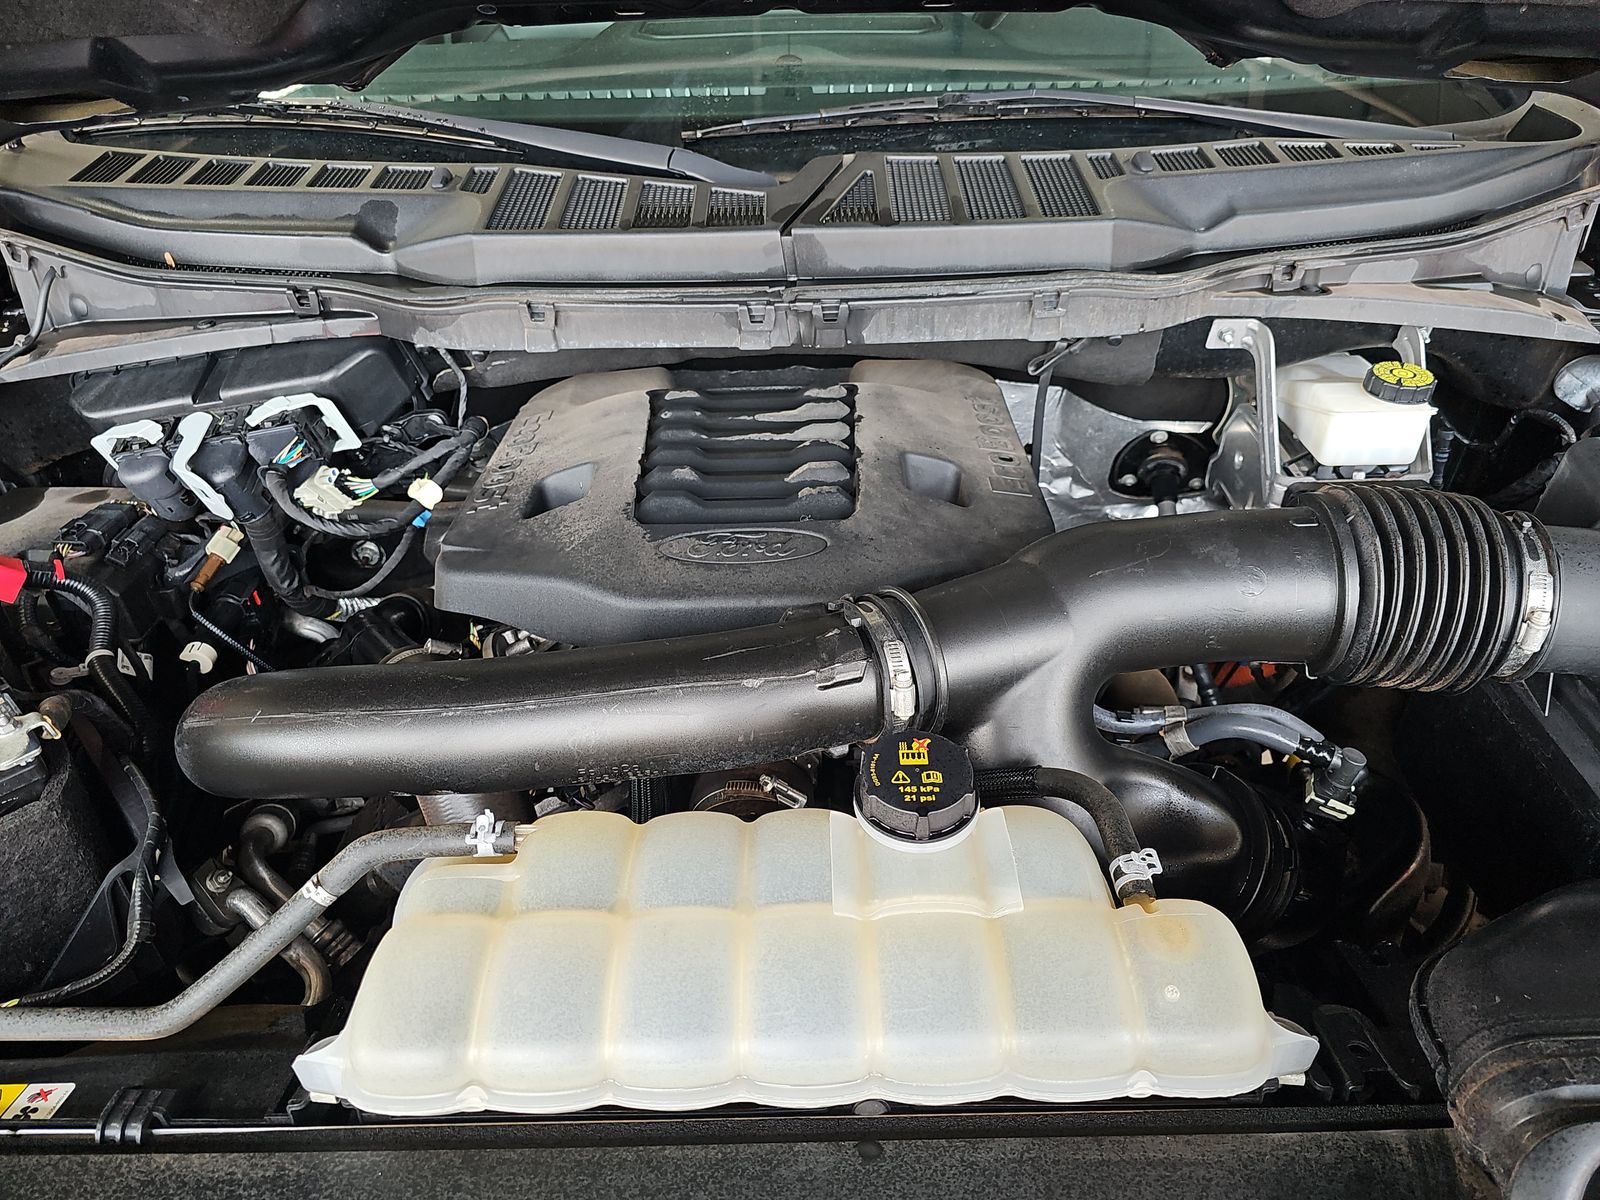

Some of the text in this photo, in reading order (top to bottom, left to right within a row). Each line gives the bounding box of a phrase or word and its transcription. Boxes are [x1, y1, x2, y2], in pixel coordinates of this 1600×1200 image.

[687, 532, 797, 558] Ford
[898, 785, 941, 793] 145 kPa
[903, 794, 937, 803] 21 psi
